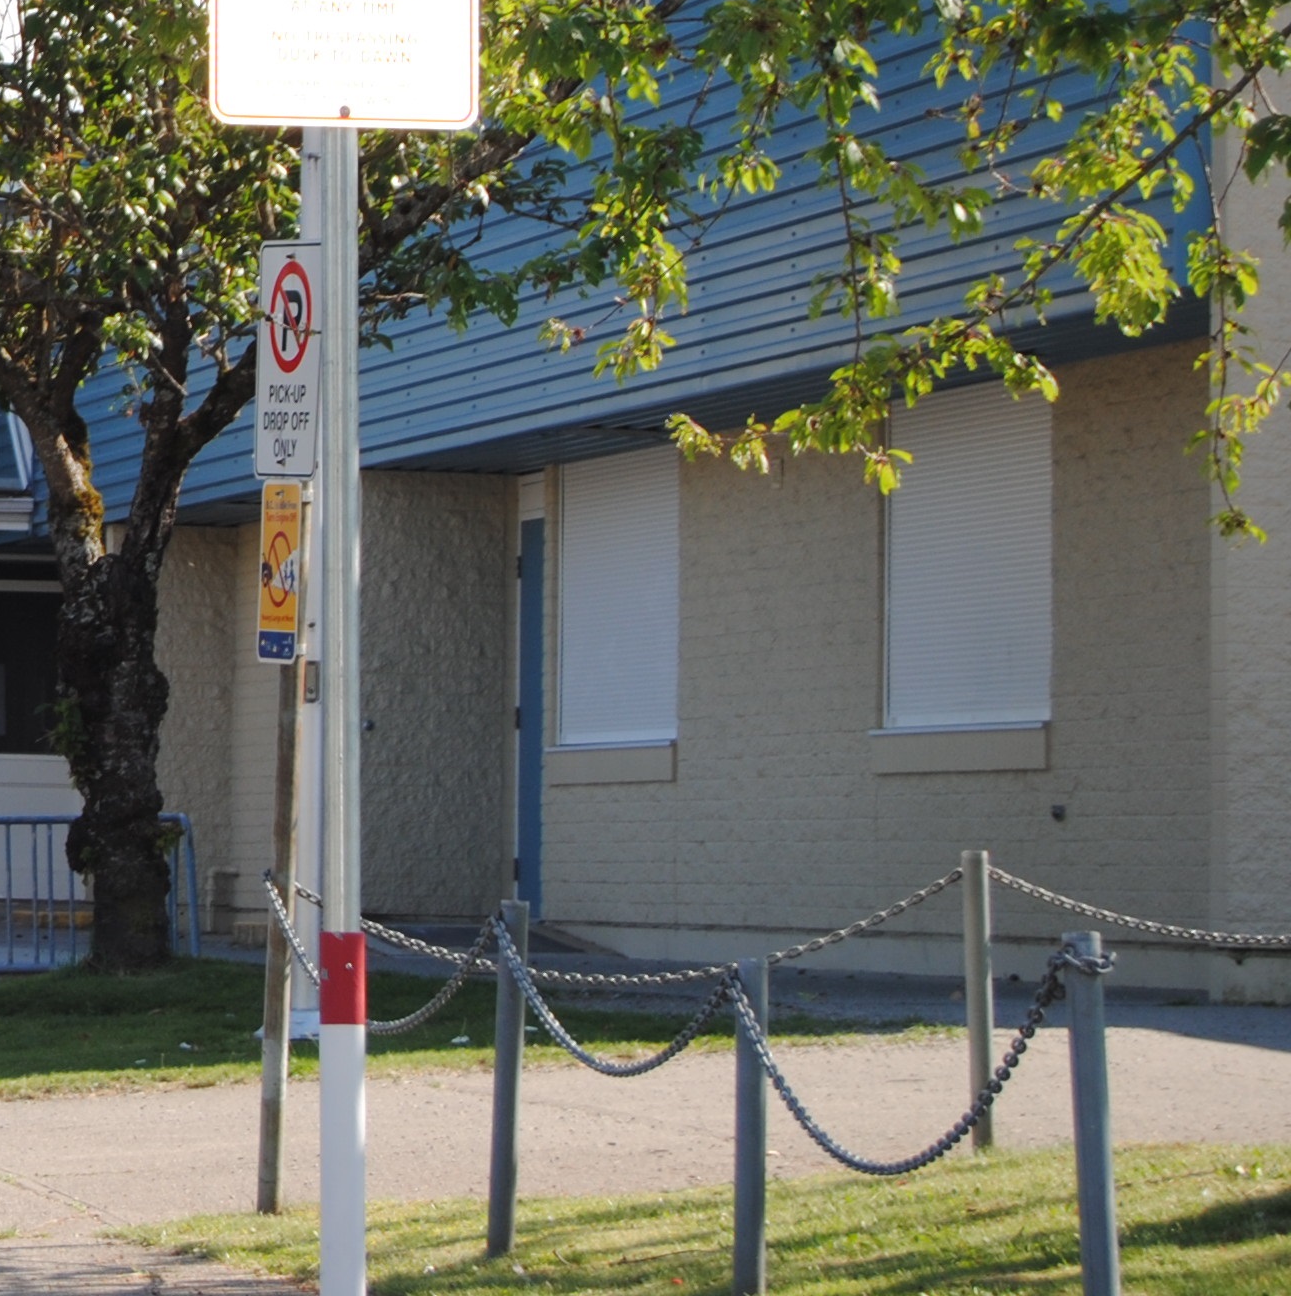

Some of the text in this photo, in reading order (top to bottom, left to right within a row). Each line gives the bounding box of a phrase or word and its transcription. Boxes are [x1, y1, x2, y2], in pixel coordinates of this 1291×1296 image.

[318, 0, 352, 13] ANY
[362, 1, 397, 15] TIME
[360, 50, 413, 64] DAWN
[269, 384, 307, 404] PICK-UP
[263, 411, 310, 431] DROP OFF
[273, 438, 298, 458] ONLY
